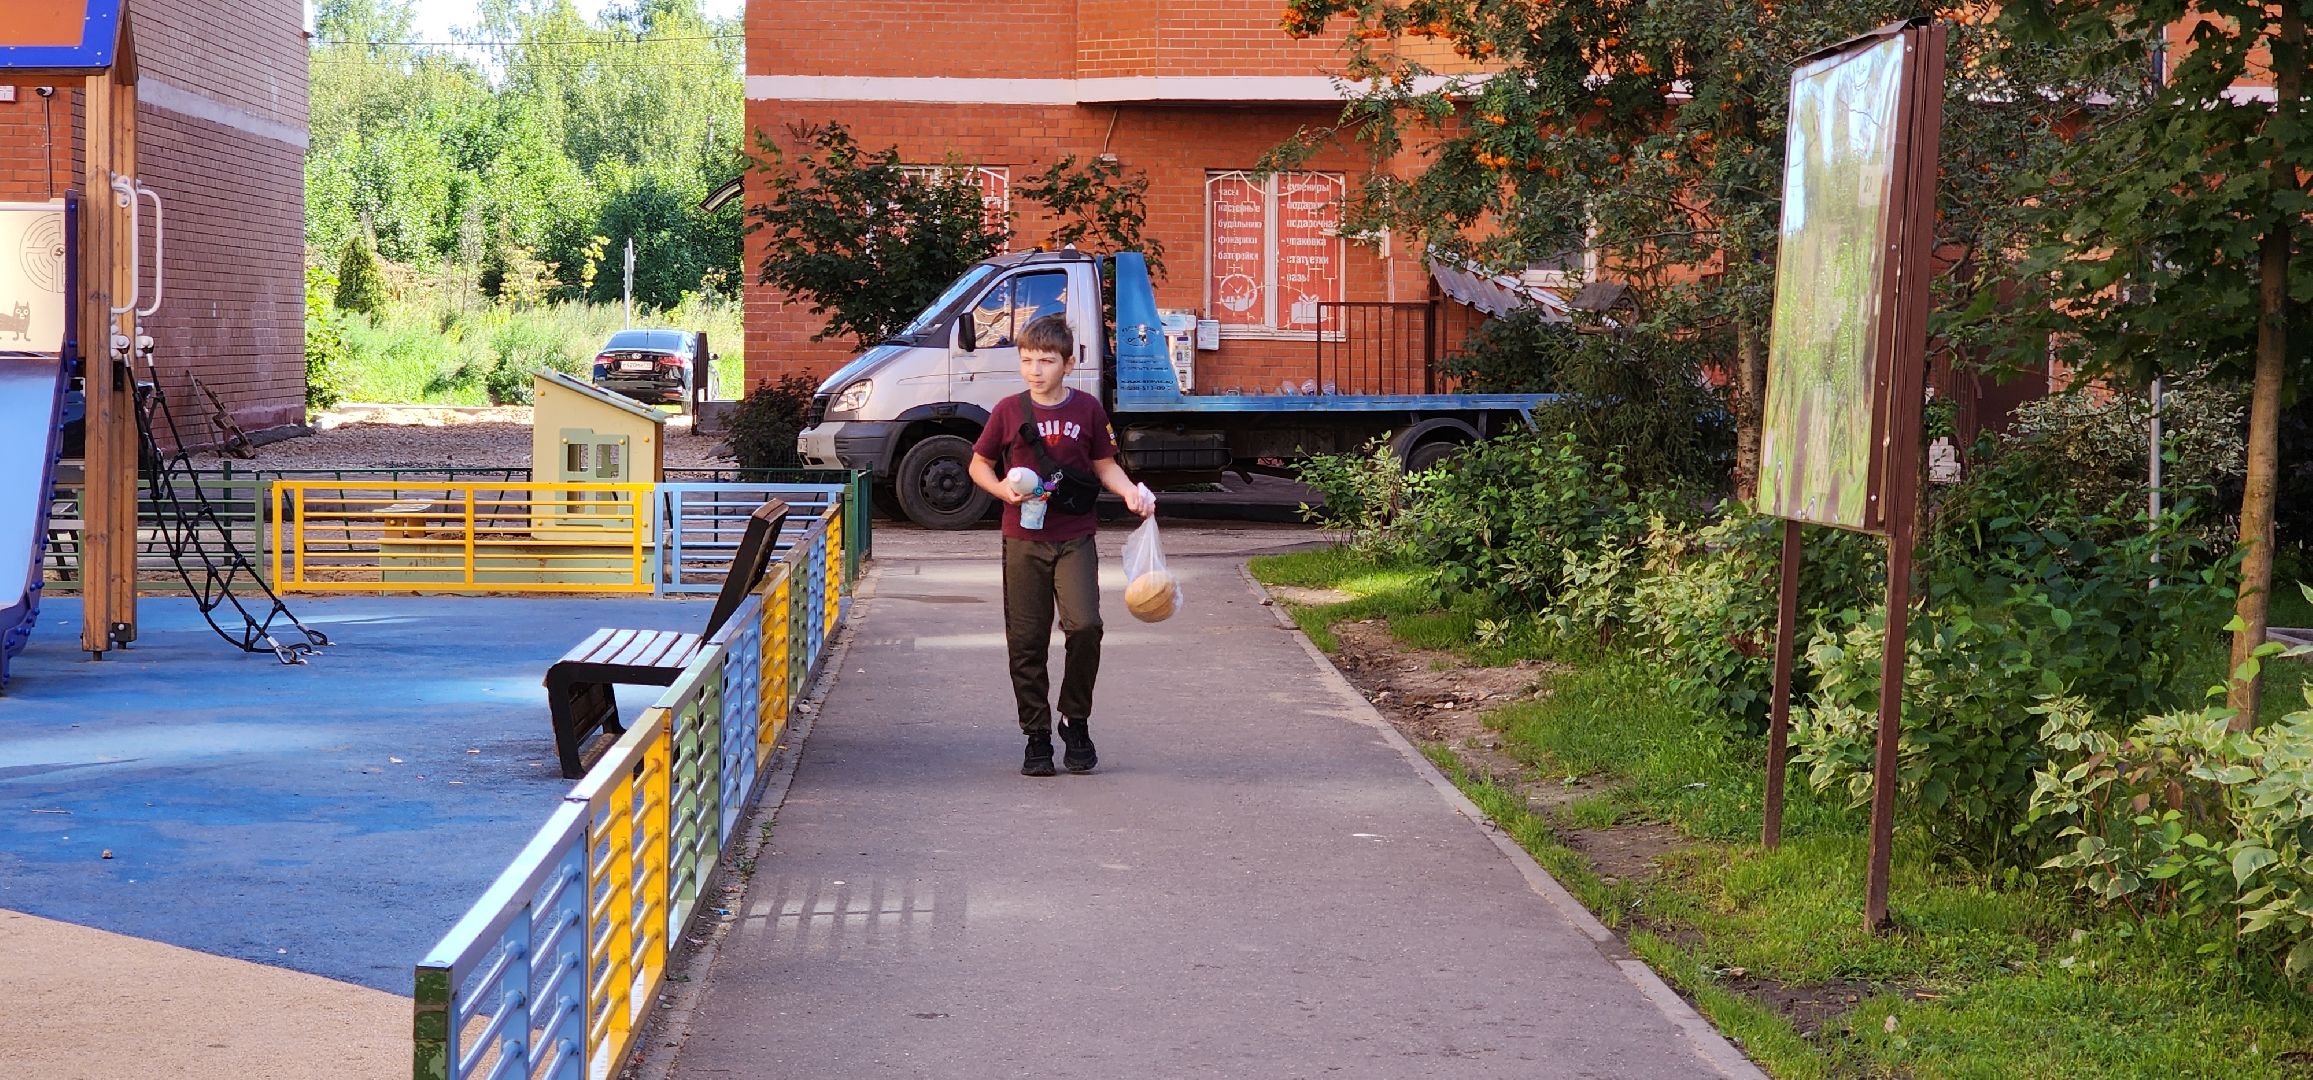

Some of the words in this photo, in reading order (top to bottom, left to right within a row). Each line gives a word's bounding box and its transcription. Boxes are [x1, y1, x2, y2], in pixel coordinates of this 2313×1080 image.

[1287, 183, 1329, 194] сувениры
[1218, 235, 1258, 246] фонарики
[1286, 237, 1327, 247] упаковка
